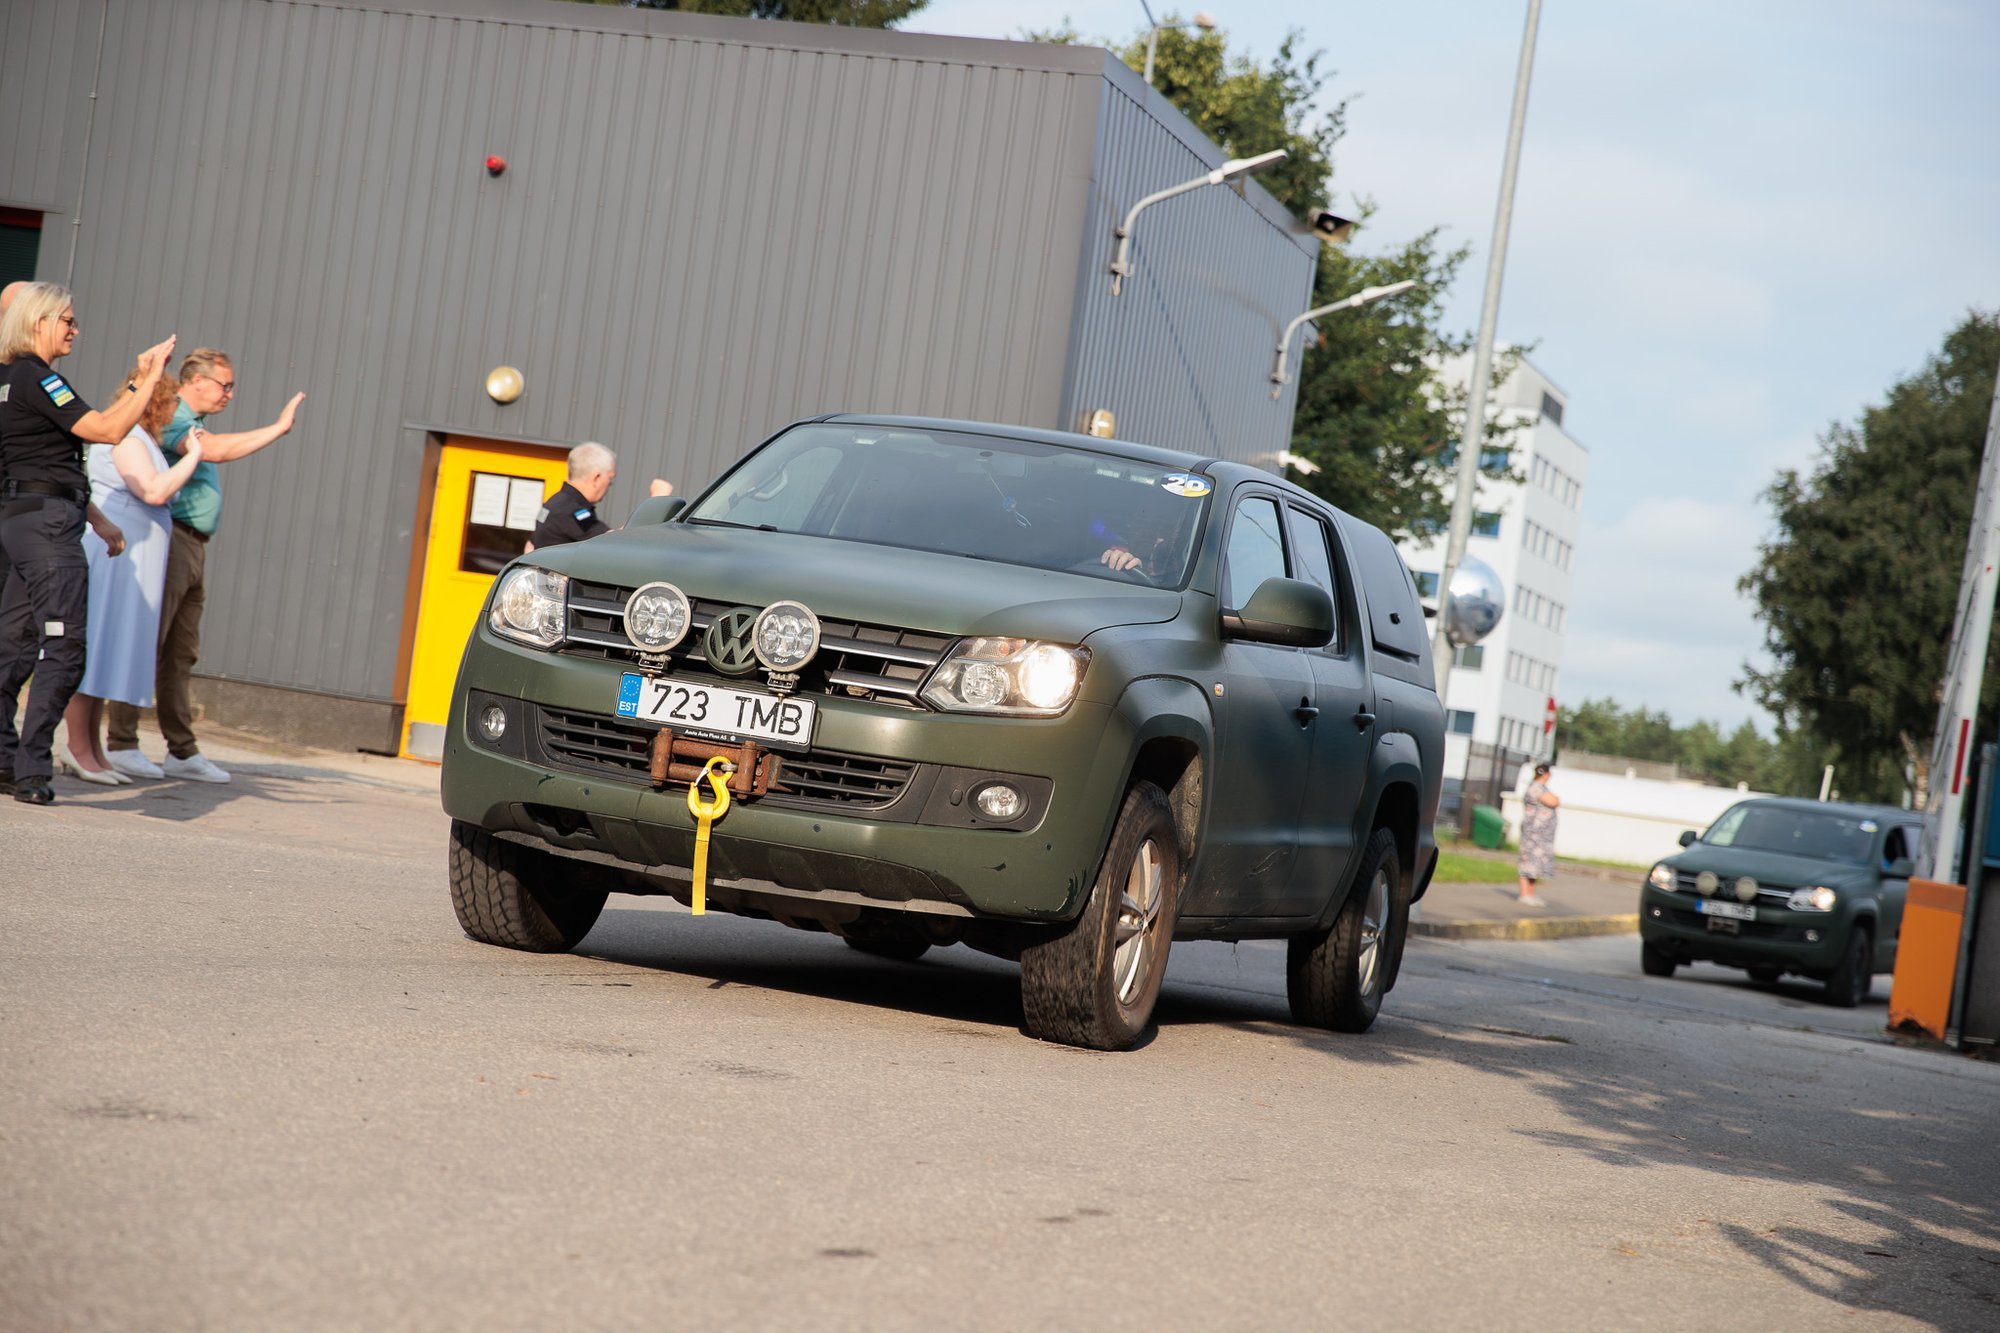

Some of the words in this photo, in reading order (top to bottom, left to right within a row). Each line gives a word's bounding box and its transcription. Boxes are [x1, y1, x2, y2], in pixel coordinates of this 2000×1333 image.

[619, 701, 637, 713] EST
[650, 683, 709, 722] 723
[735, 695, 803, 736] TMB
